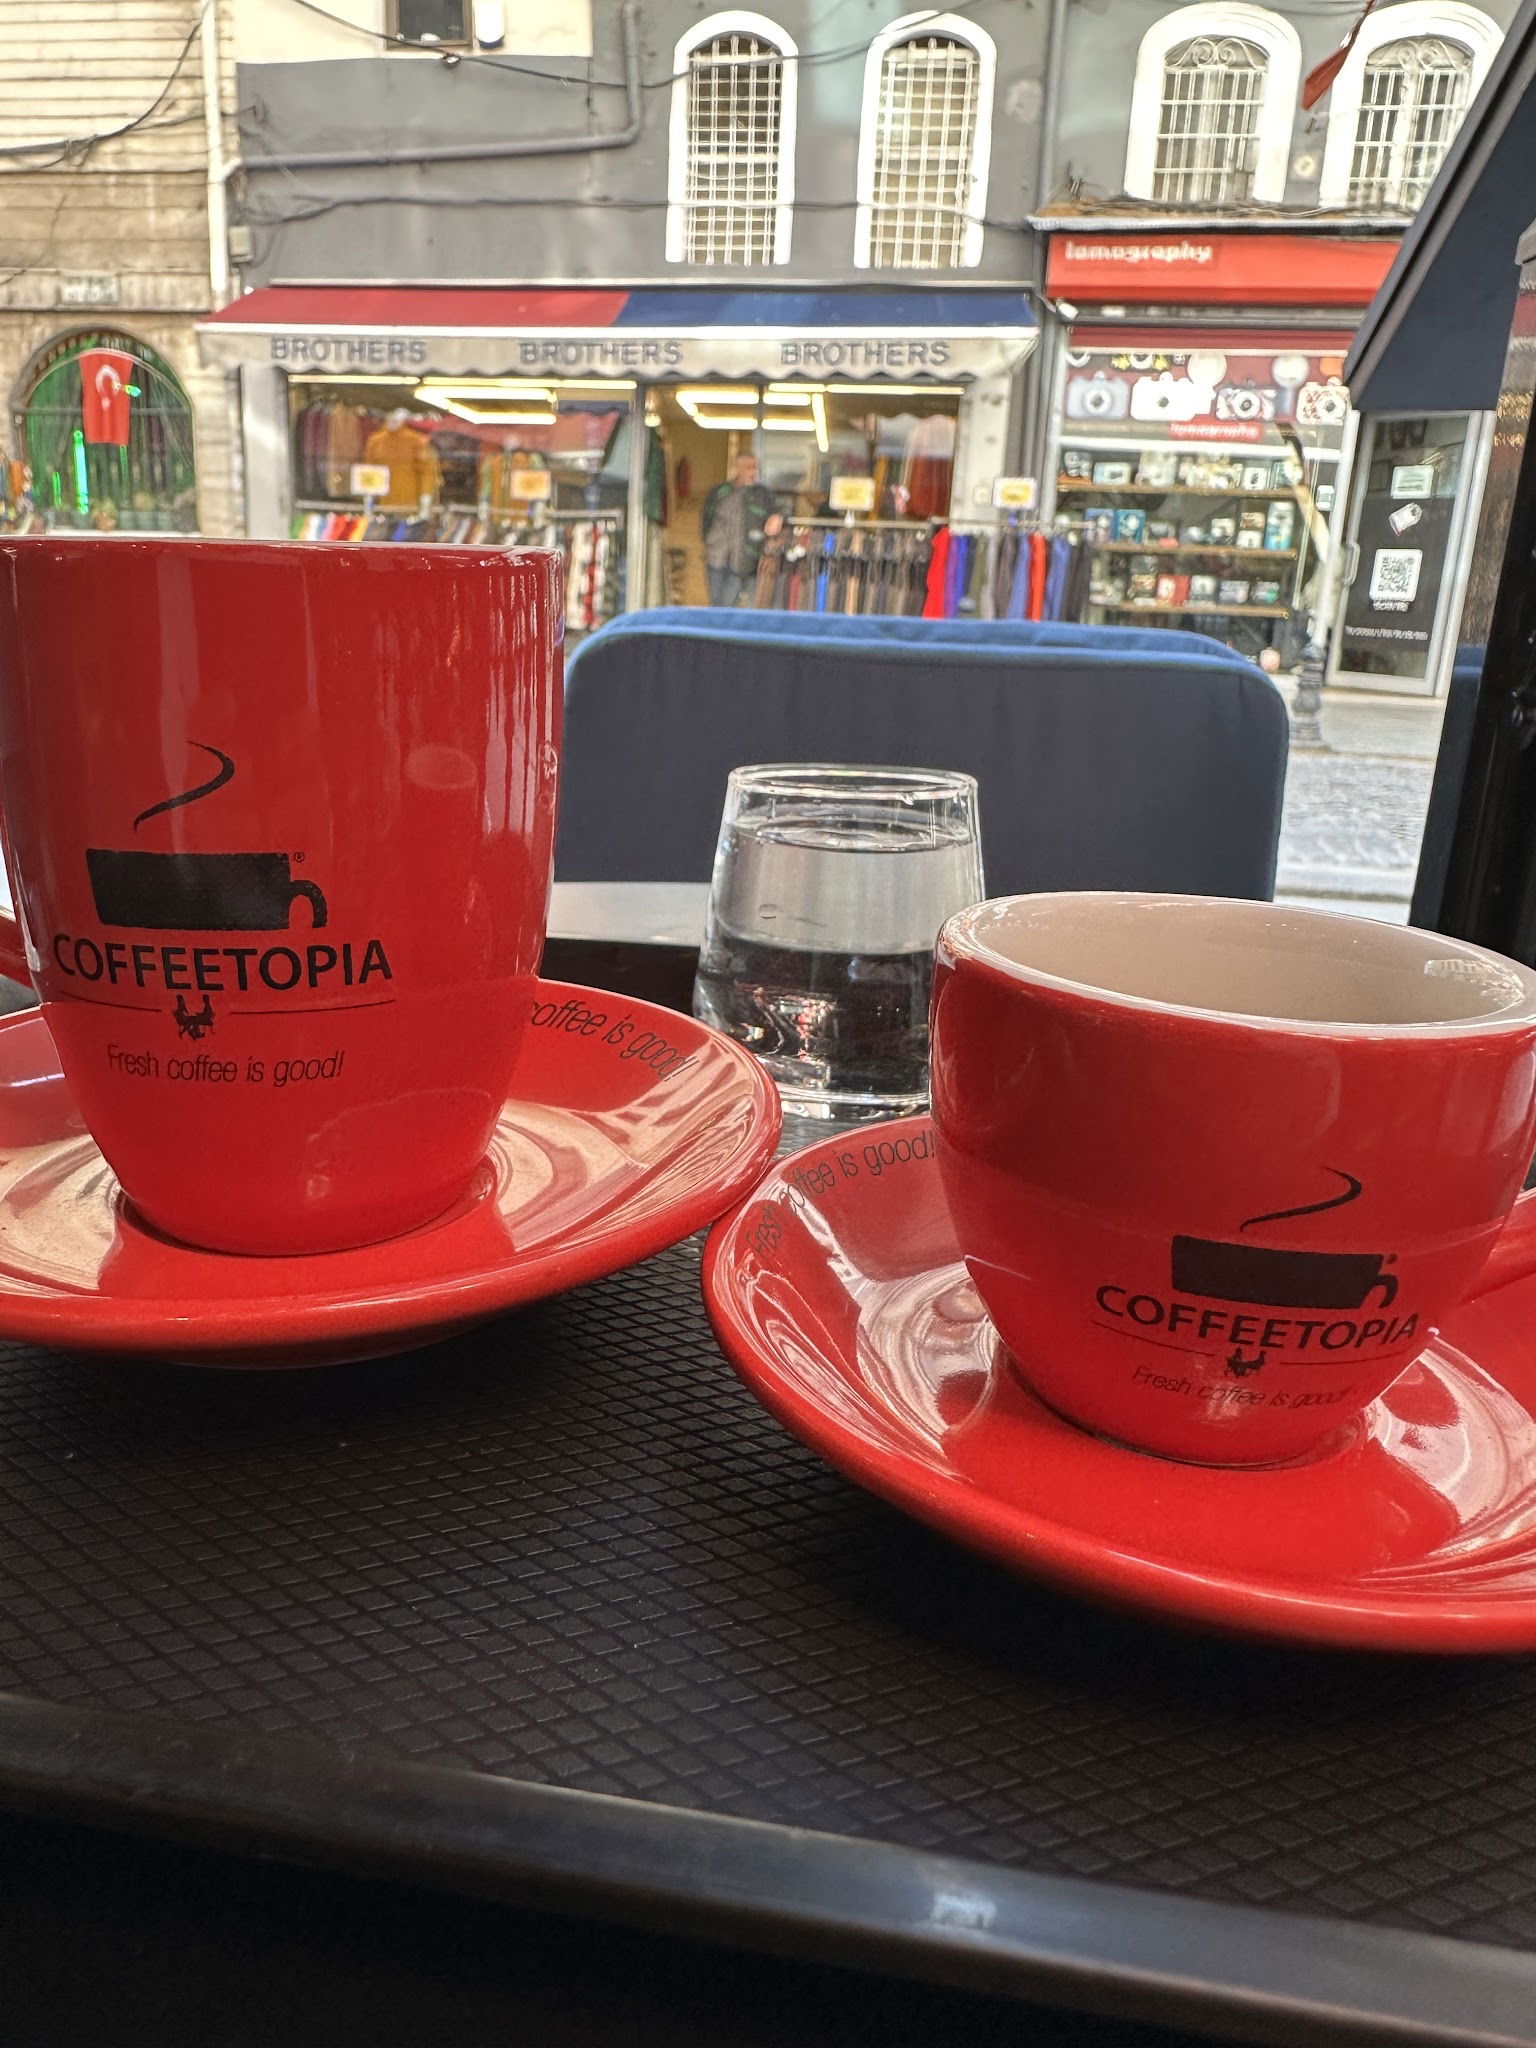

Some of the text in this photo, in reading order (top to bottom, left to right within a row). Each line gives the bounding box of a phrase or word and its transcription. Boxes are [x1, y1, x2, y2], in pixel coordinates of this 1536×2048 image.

[270, 336, 427, 366] BROTHERS
[519, 340, 684, 367] BROTHERS
[780, 340, 951, 367] BROTHERS
[52, 933, 393, 991] COFFEETOPIA
[602, 1014, 634, 1045] is
[107, 1044, 346, 1088] Fresh coffee is good!
[834, 1149, 859, 1178] is
[863, 1130, 937, 1176] good!
[1095, 1285, 1420, 1350] COFFEETOPIA
[1132, 1364, 1192, 1396] Fresh
[1268, 1388, 1290, 1407] is
